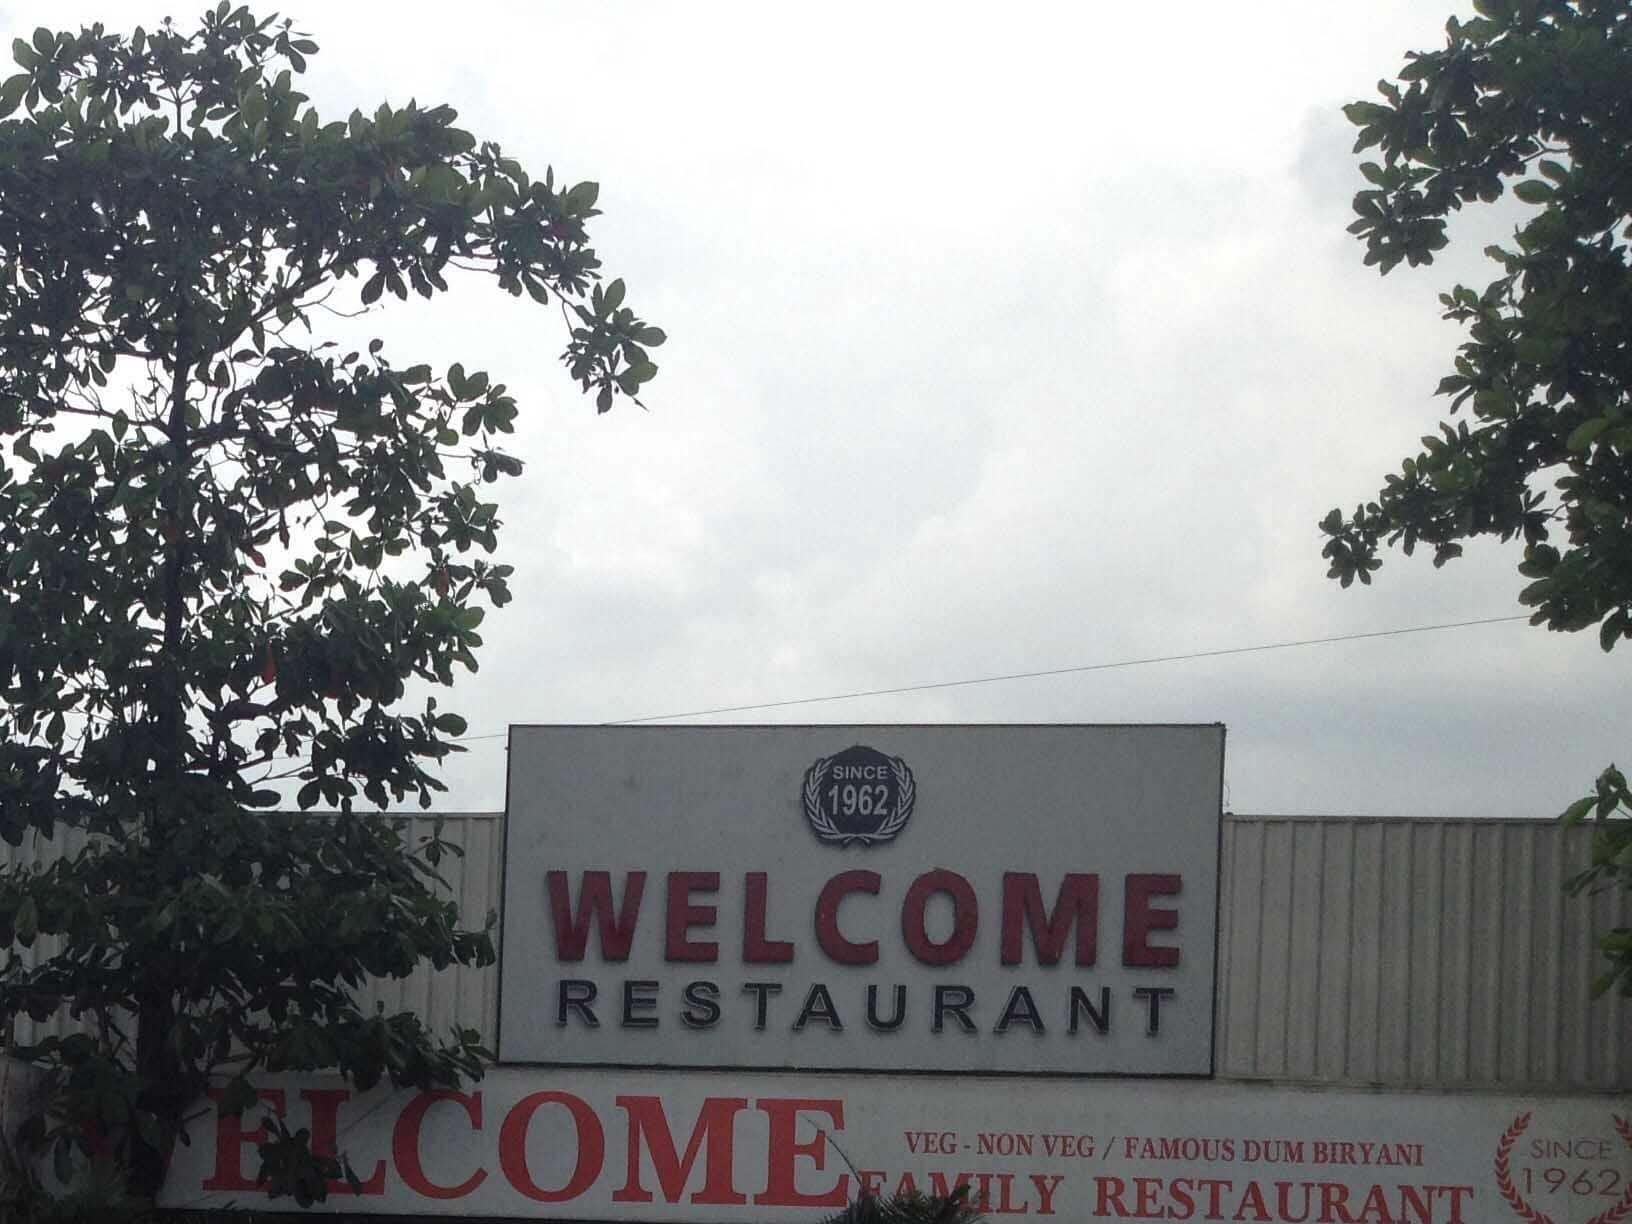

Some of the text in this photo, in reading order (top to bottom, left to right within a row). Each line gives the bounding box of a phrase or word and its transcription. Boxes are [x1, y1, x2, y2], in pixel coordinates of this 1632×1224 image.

[832, 766, 888, 780] SINCE
[828, 784, 888, 816] 1962
[546, 867, 1182, 968] WELCOME
[555, 979, 1175, 1035] RESTAURANT
[98, 1088, 850, 1207] ELCOME
[904, 1131, 958, 1155] VEG
[976, 1132, 1035, 1157] NON
[1042, 1133, 1095, 1158] VEG
[1123, 1136, 1234, 1162] FAMOUS
[1243, 1140, 1305, 1164] DUM
[1312, 1141, 1425, 1167] BIRYANI
[1529, 1138, 1613, 1160] SINCE
[1522, 1167, 1622, 1197] 1962
